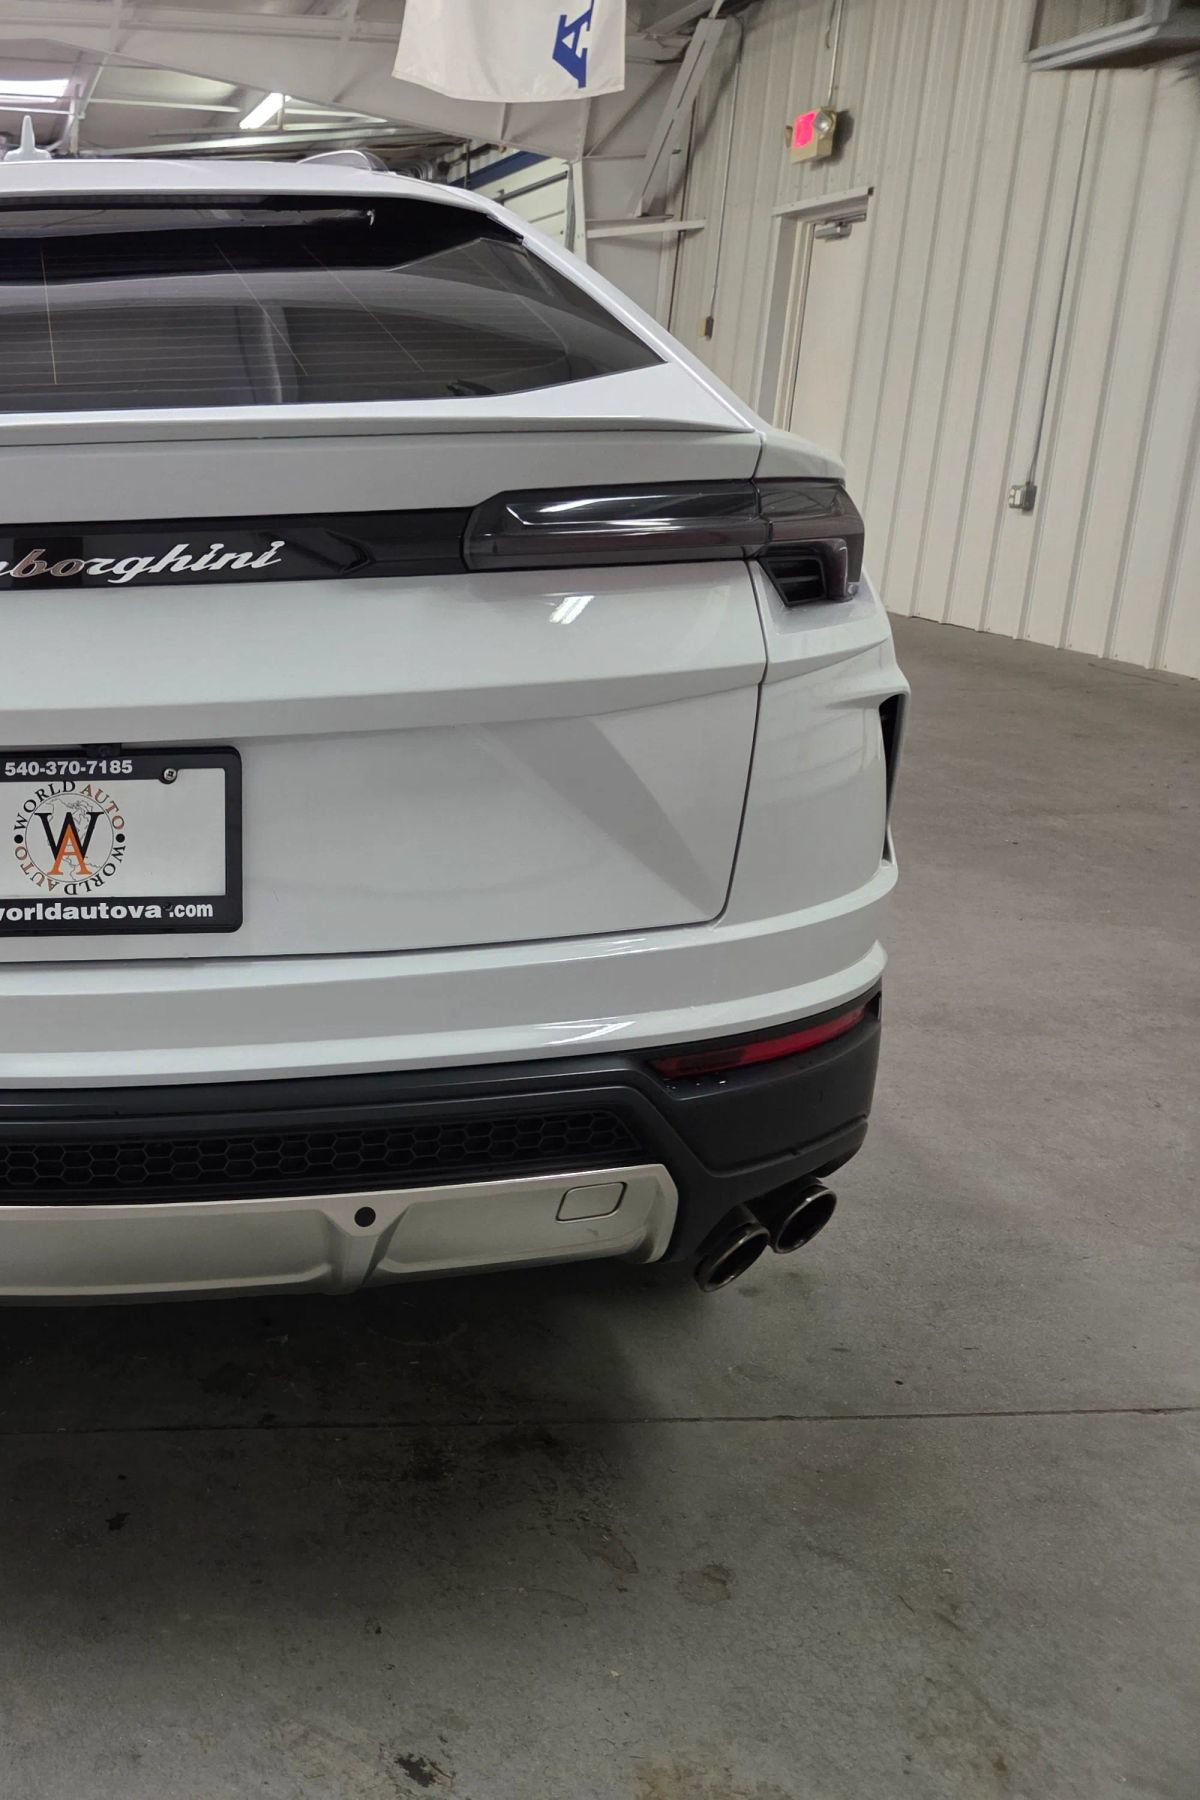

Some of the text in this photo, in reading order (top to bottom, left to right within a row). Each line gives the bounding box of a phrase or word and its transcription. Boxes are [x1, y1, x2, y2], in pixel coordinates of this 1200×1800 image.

[4, 759, 133, 776] 540-370-7185
[13, 780, 126, 831] WORLD AUTO
[15, 845, 126, 895] WORLD AUTO
